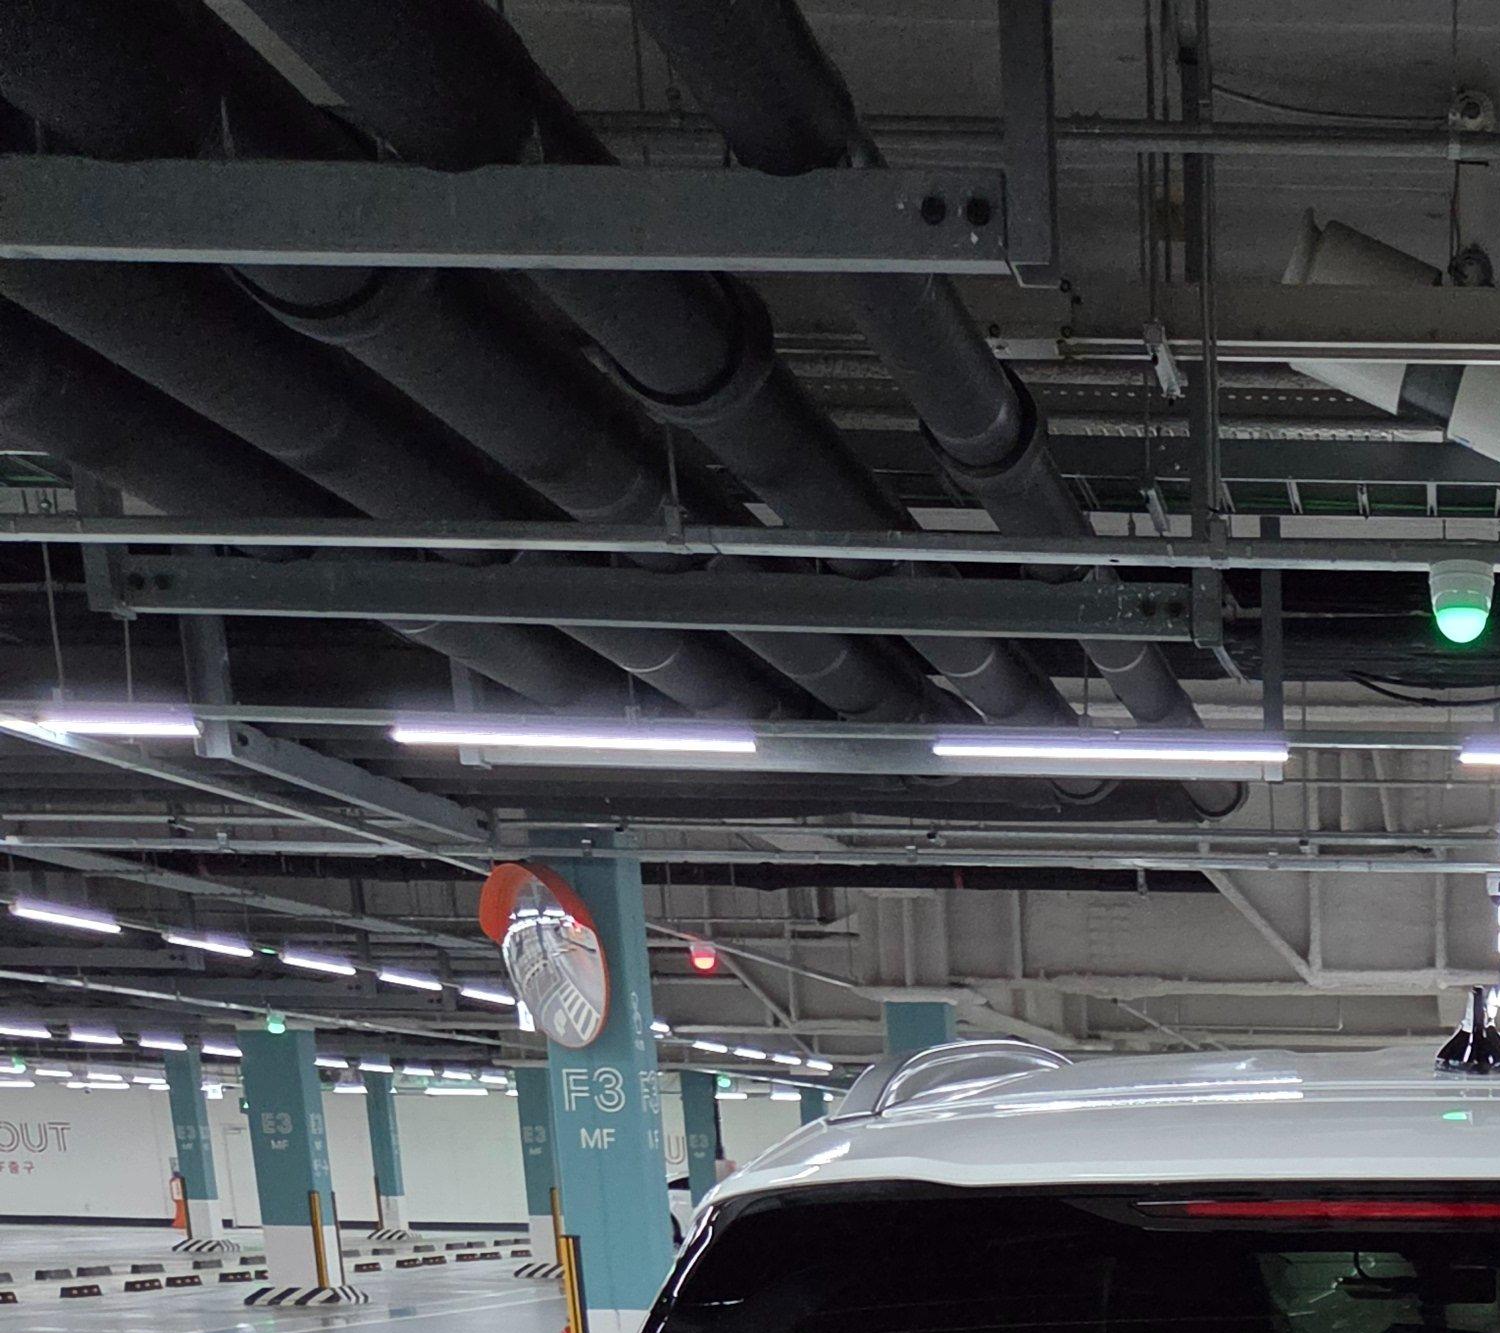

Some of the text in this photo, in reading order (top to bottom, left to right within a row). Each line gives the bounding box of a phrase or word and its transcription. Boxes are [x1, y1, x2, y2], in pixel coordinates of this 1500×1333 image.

[562, 1067, 625, 1113] F3
[261, 1112, 294, 1134] E3
[0, 1121, 71, 1153] OUT
[580, 1127, 616, 1149] MF
